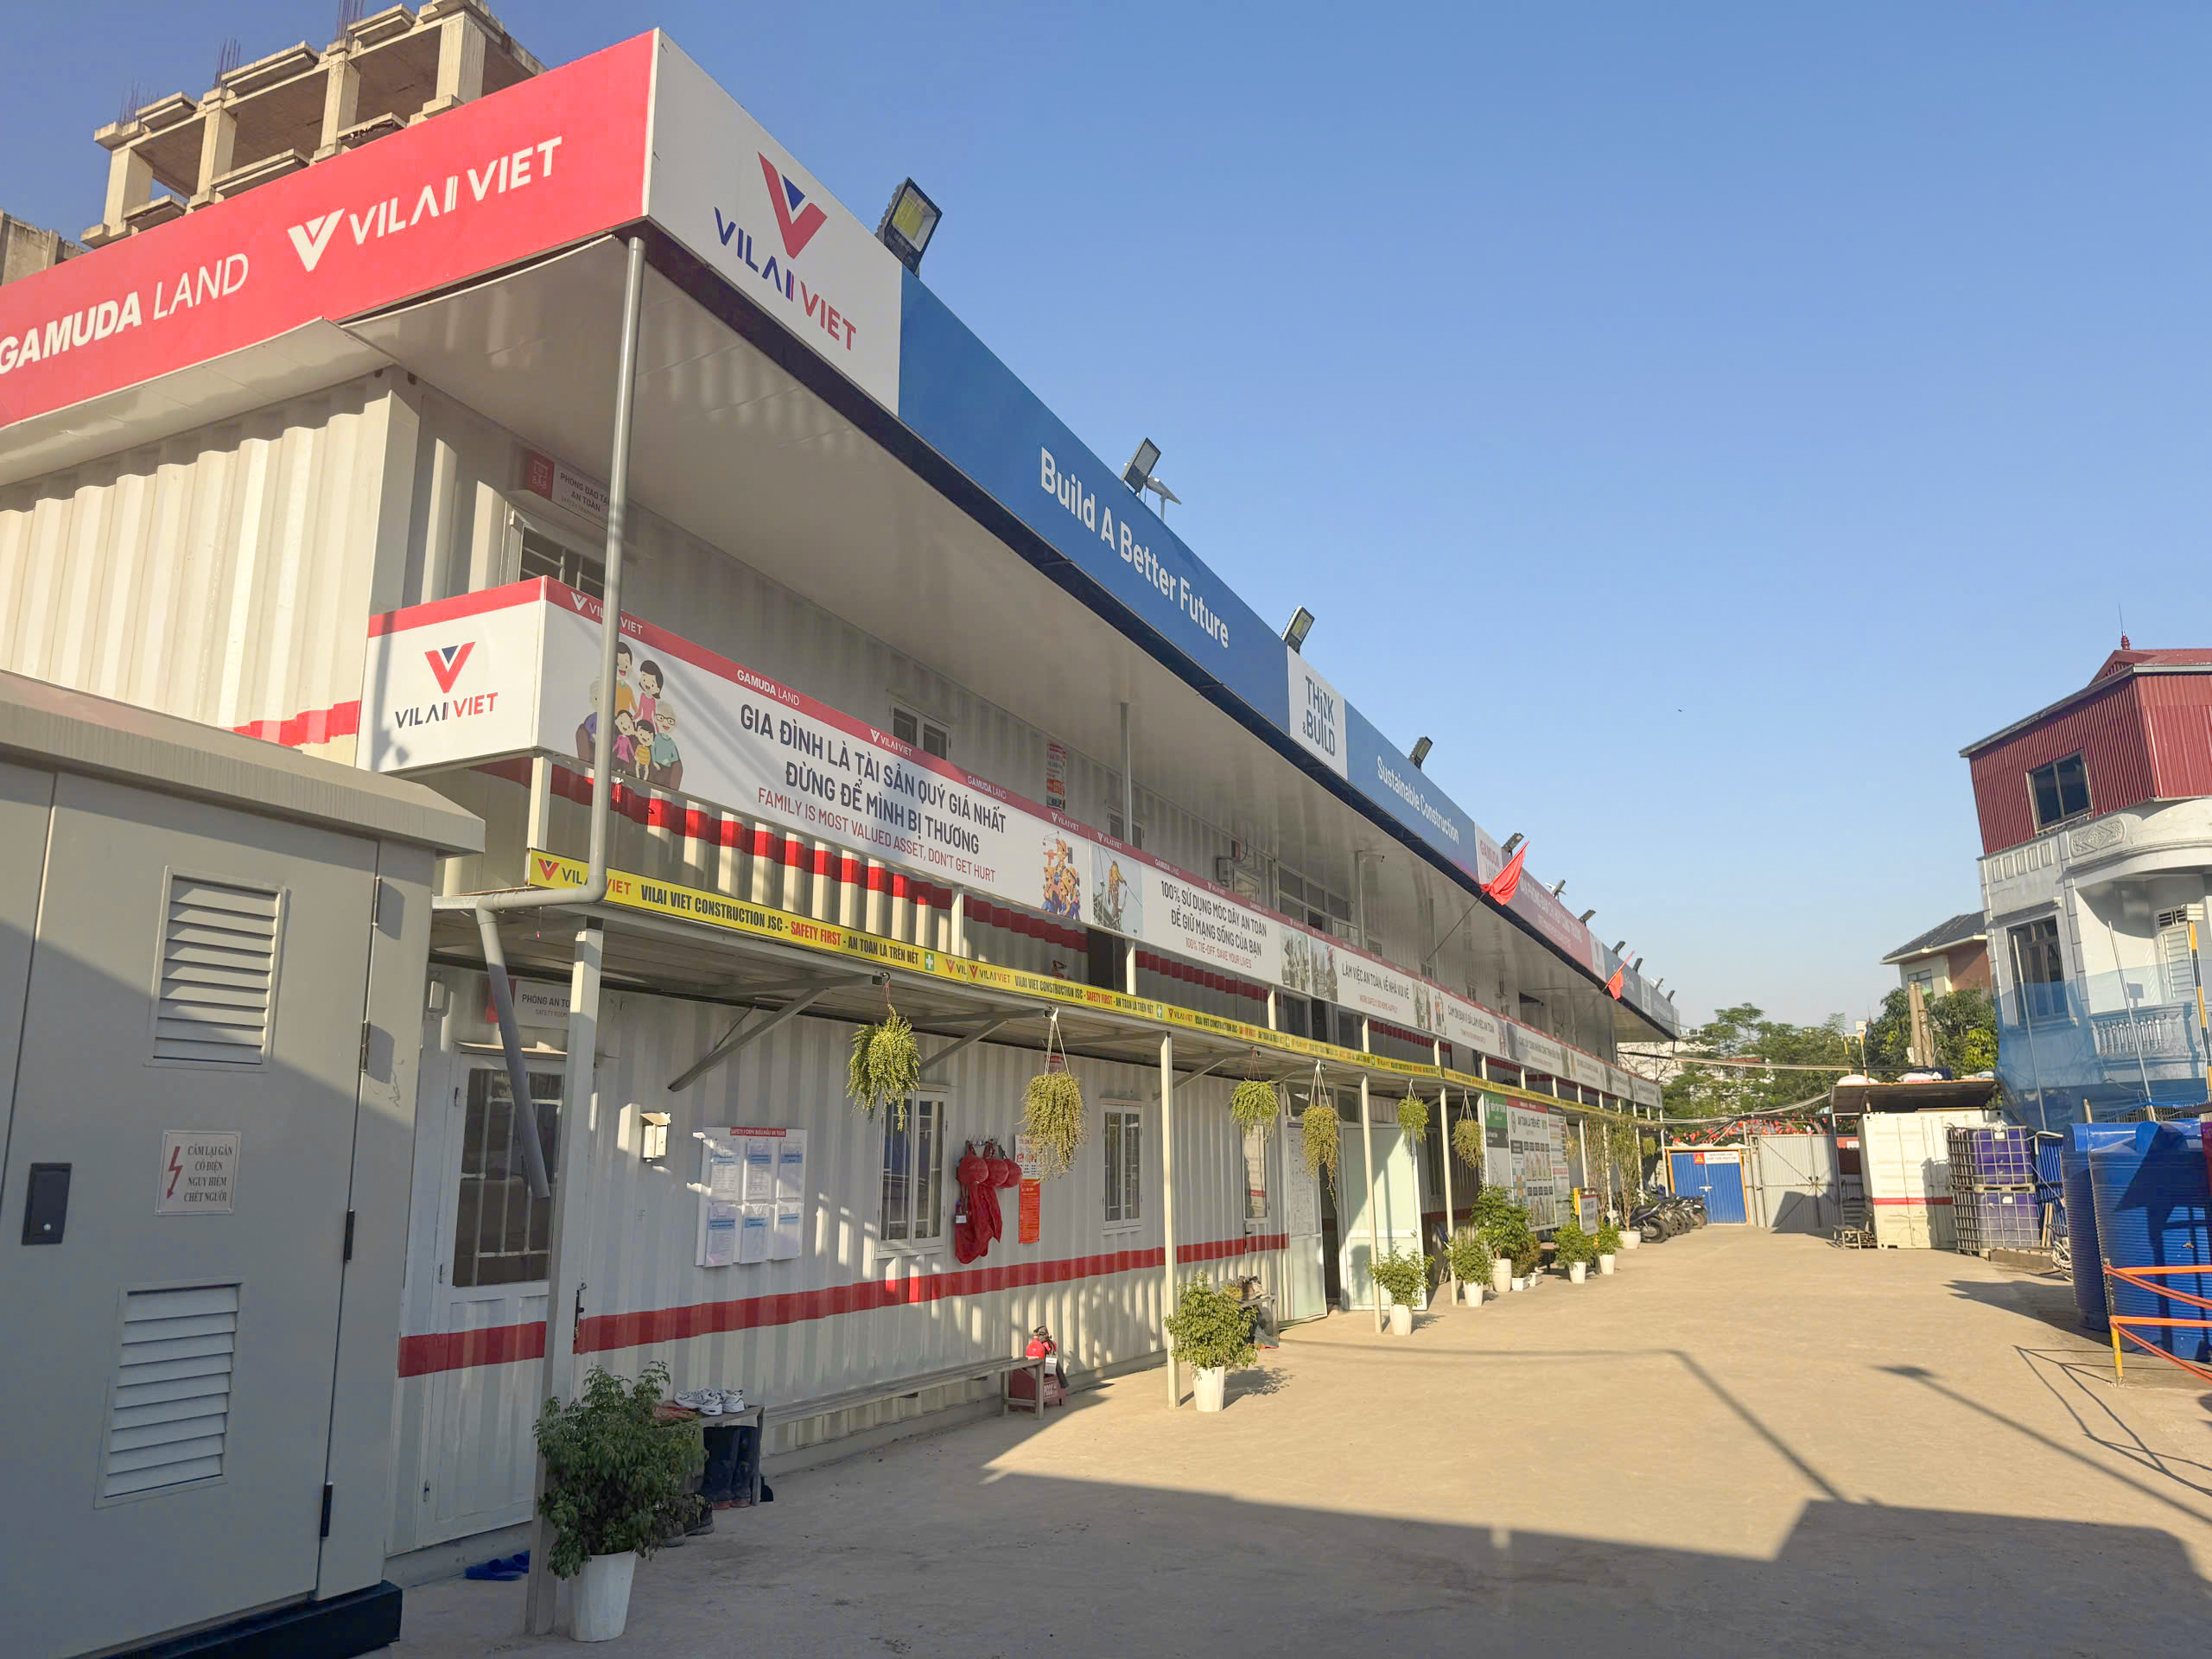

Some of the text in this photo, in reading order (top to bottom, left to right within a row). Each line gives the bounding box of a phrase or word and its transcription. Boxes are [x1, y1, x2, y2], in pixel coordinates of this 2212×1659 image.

[348, 136, 563, 245] VILAI VIET
[715, 207, 856, 351] VILAI VIET
[0, 252, 250, 375] GAMUDA LAND
[1041, 446, 1229, 648] Build A Better Future
[620, 616, 643, 635] VIET
[395, 692, 499, 728] VILAI VIET
[737, 670, 799, 706] GAMUDA LAND
[741, 704, 1006, 834] GIA ĐÌNH LÀ TÀI SẢN QUÝ GIÁ NHẤT
[880, 736, 912, 757] VILAI VIET
[785, 760, 979, 855] ĐỪNG ĐỂ MÌNH BỊ THƯƠNG
[967, 775, 1007, 799] GAMUDA LAND
[1377, 755, 1459, 844] Sustainable Construction
[758, 786, 995, 882] FAMILY IS MOST VALUED ASSET, DON'T GET HURT
[562, 867, 588, 886] VIL
[607, 877, 632, 895] VIET
[640, 884, 667, 906] VILAI
[670, 891, 691, 911] VIET
[694, 897, 765, 928] CONSTRUCTION
[766, 914, 783, 931] JSC
[791, 921, 818, 940] SAFETY
[820, 929, 842, 946] FIRST
[848, 936, 858, 950] AN
[1161, 880, 1180, 903] 100%
[1181, 887, 1192, 907] SỬ
[1192, 894, 1211, 916] DỤNG
[1212, 902, 1227, 921] MÓC
[1241, 914, 1250, 932] AN
[1171, 905, 1181, 927] ĐỂ
[1195, 918, 1216, 940] MẠNG
[1249, 939, 1262, 958] BẠN
[1185, 937, 1198, 951] 100%
[1217, 948, 1229, 961] SAVE
[1229, 951, 1240, 964] YOUR
[549, 997, 559, 1007] AN
[561, 998, 570, 1007] TO
[979, 969, 996, 981] VILAI
[998, 974, 1010, 983] VIET
[1039, 981, 1074, 998] CONSTRUCTION
[188, 1176, 209, 1186] NGUY
